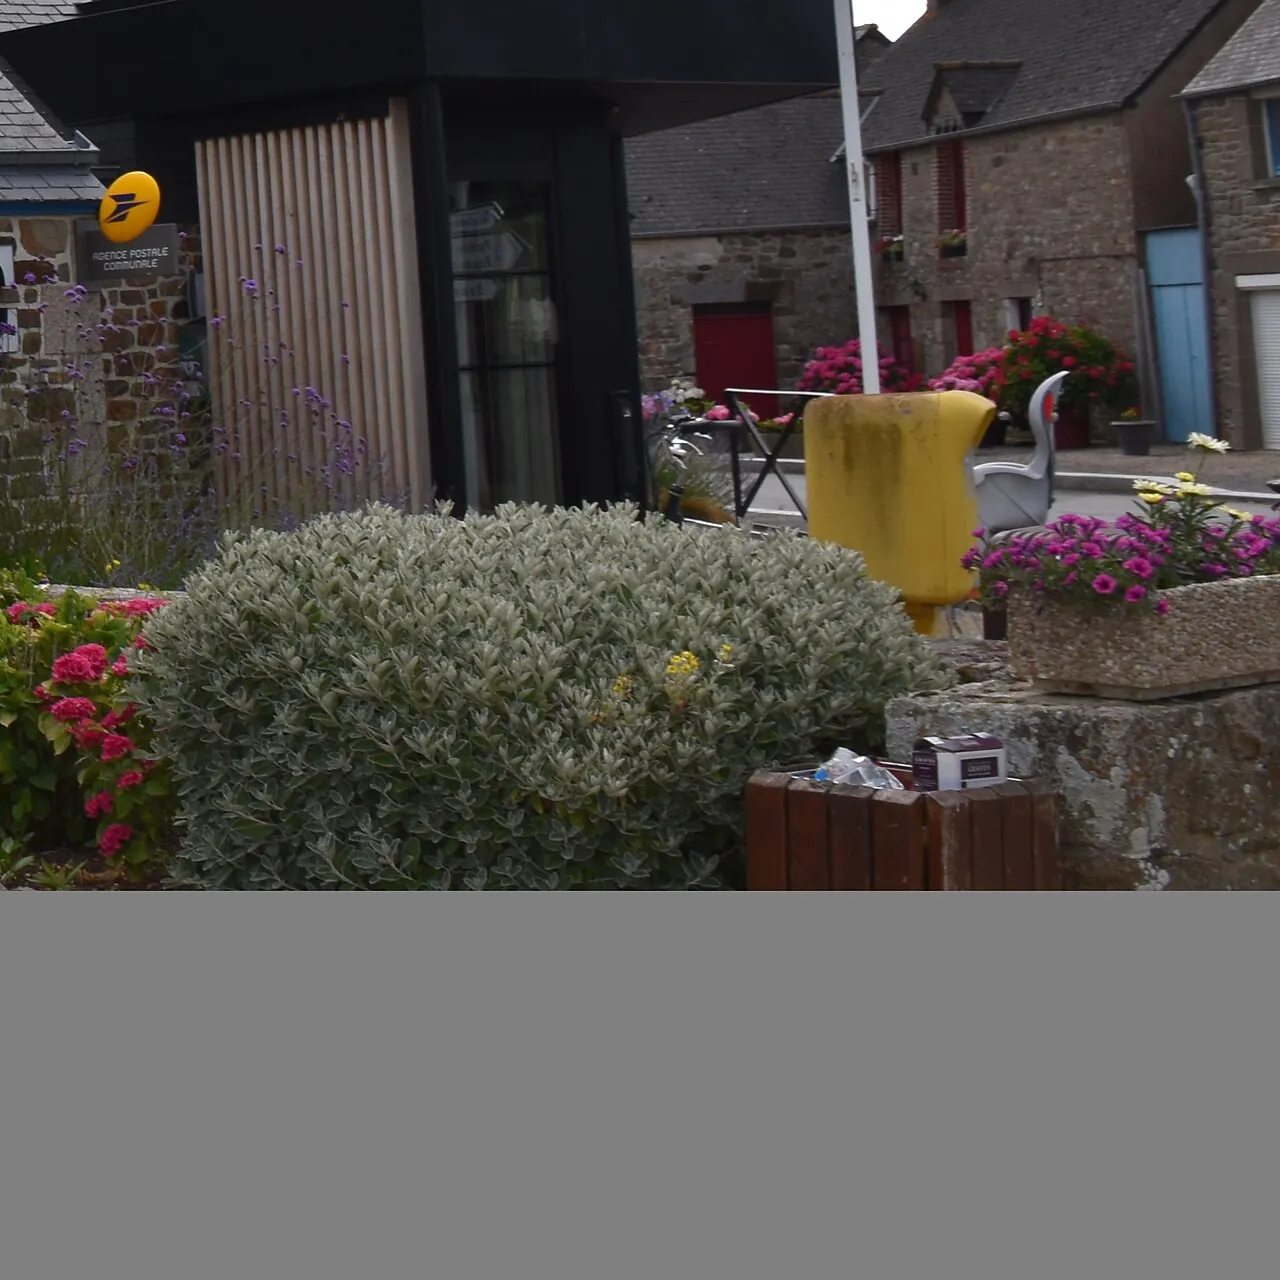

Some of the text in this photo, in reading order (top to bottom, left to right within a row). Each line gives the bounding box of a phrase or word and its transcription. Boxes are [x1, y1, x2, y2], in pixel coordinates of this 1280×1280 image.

[92, 246, 169, 261] AGENCE POSTALE
[103, 258, 159, 272] COMMUNALE
